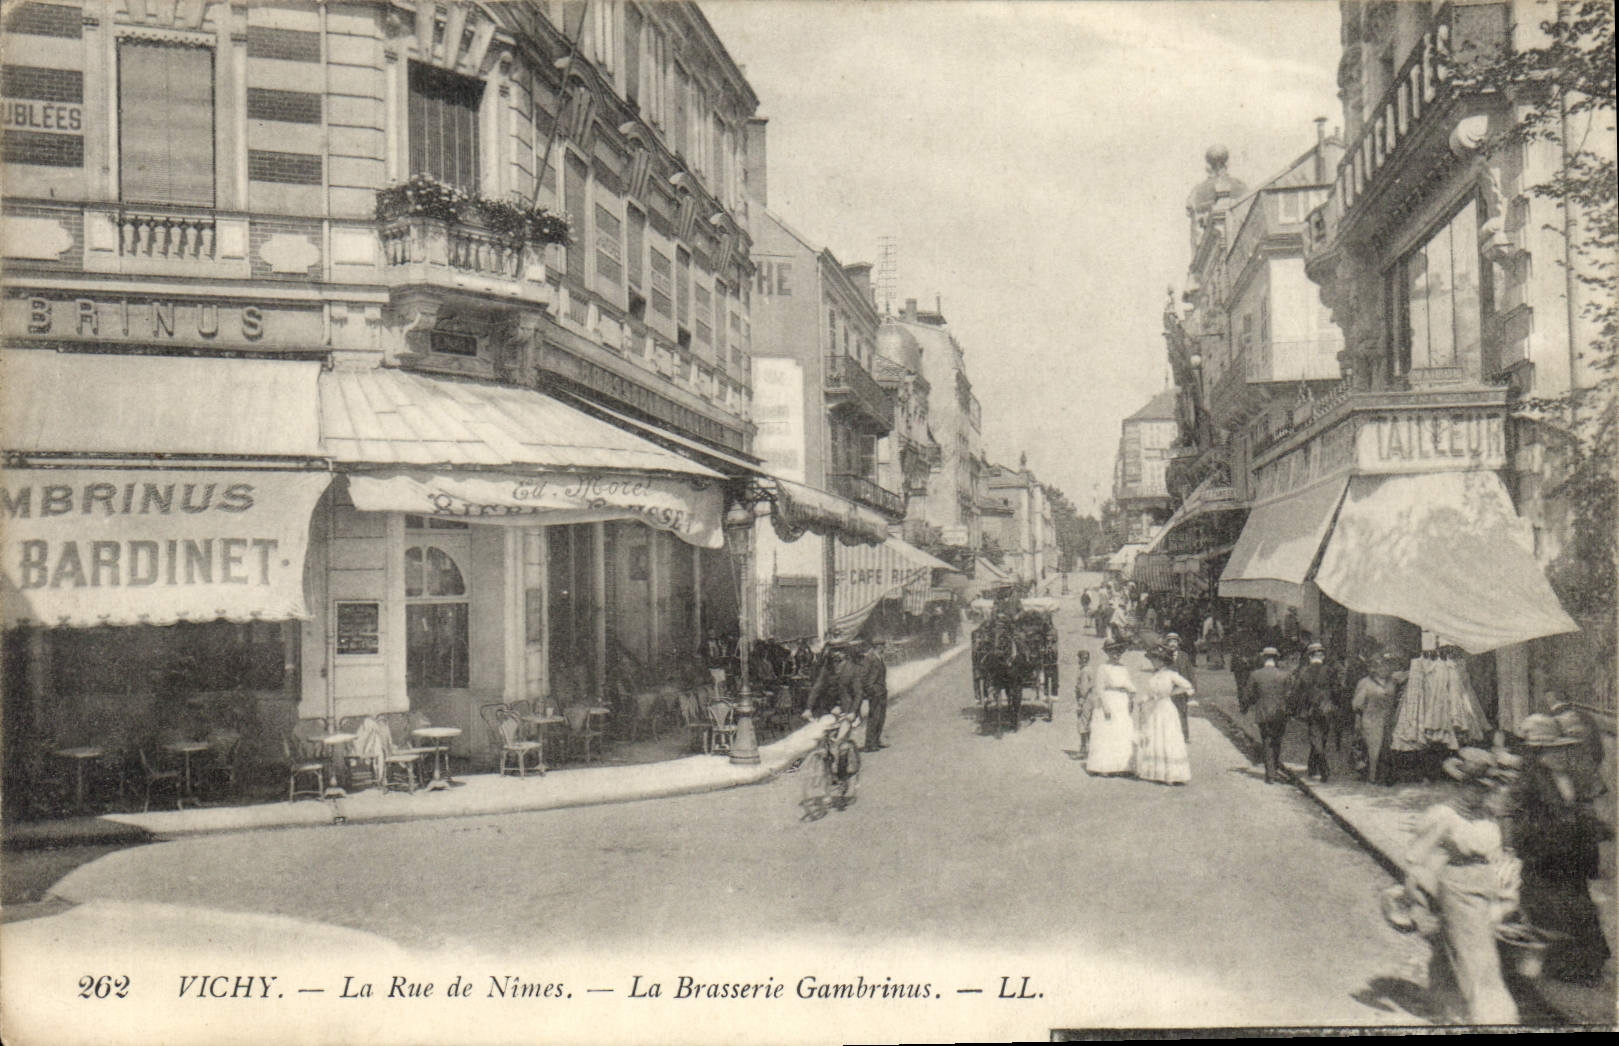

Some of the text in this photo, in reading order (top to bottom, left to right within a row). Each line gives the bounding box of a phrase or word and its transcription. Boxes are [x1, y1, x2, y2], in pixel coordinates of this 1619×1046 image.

[28, 297, 264, 342] BRINUS
[1369, 411, 1504, 462] TAILLEUR
[1, 481, 256, 519] MBRINUS
